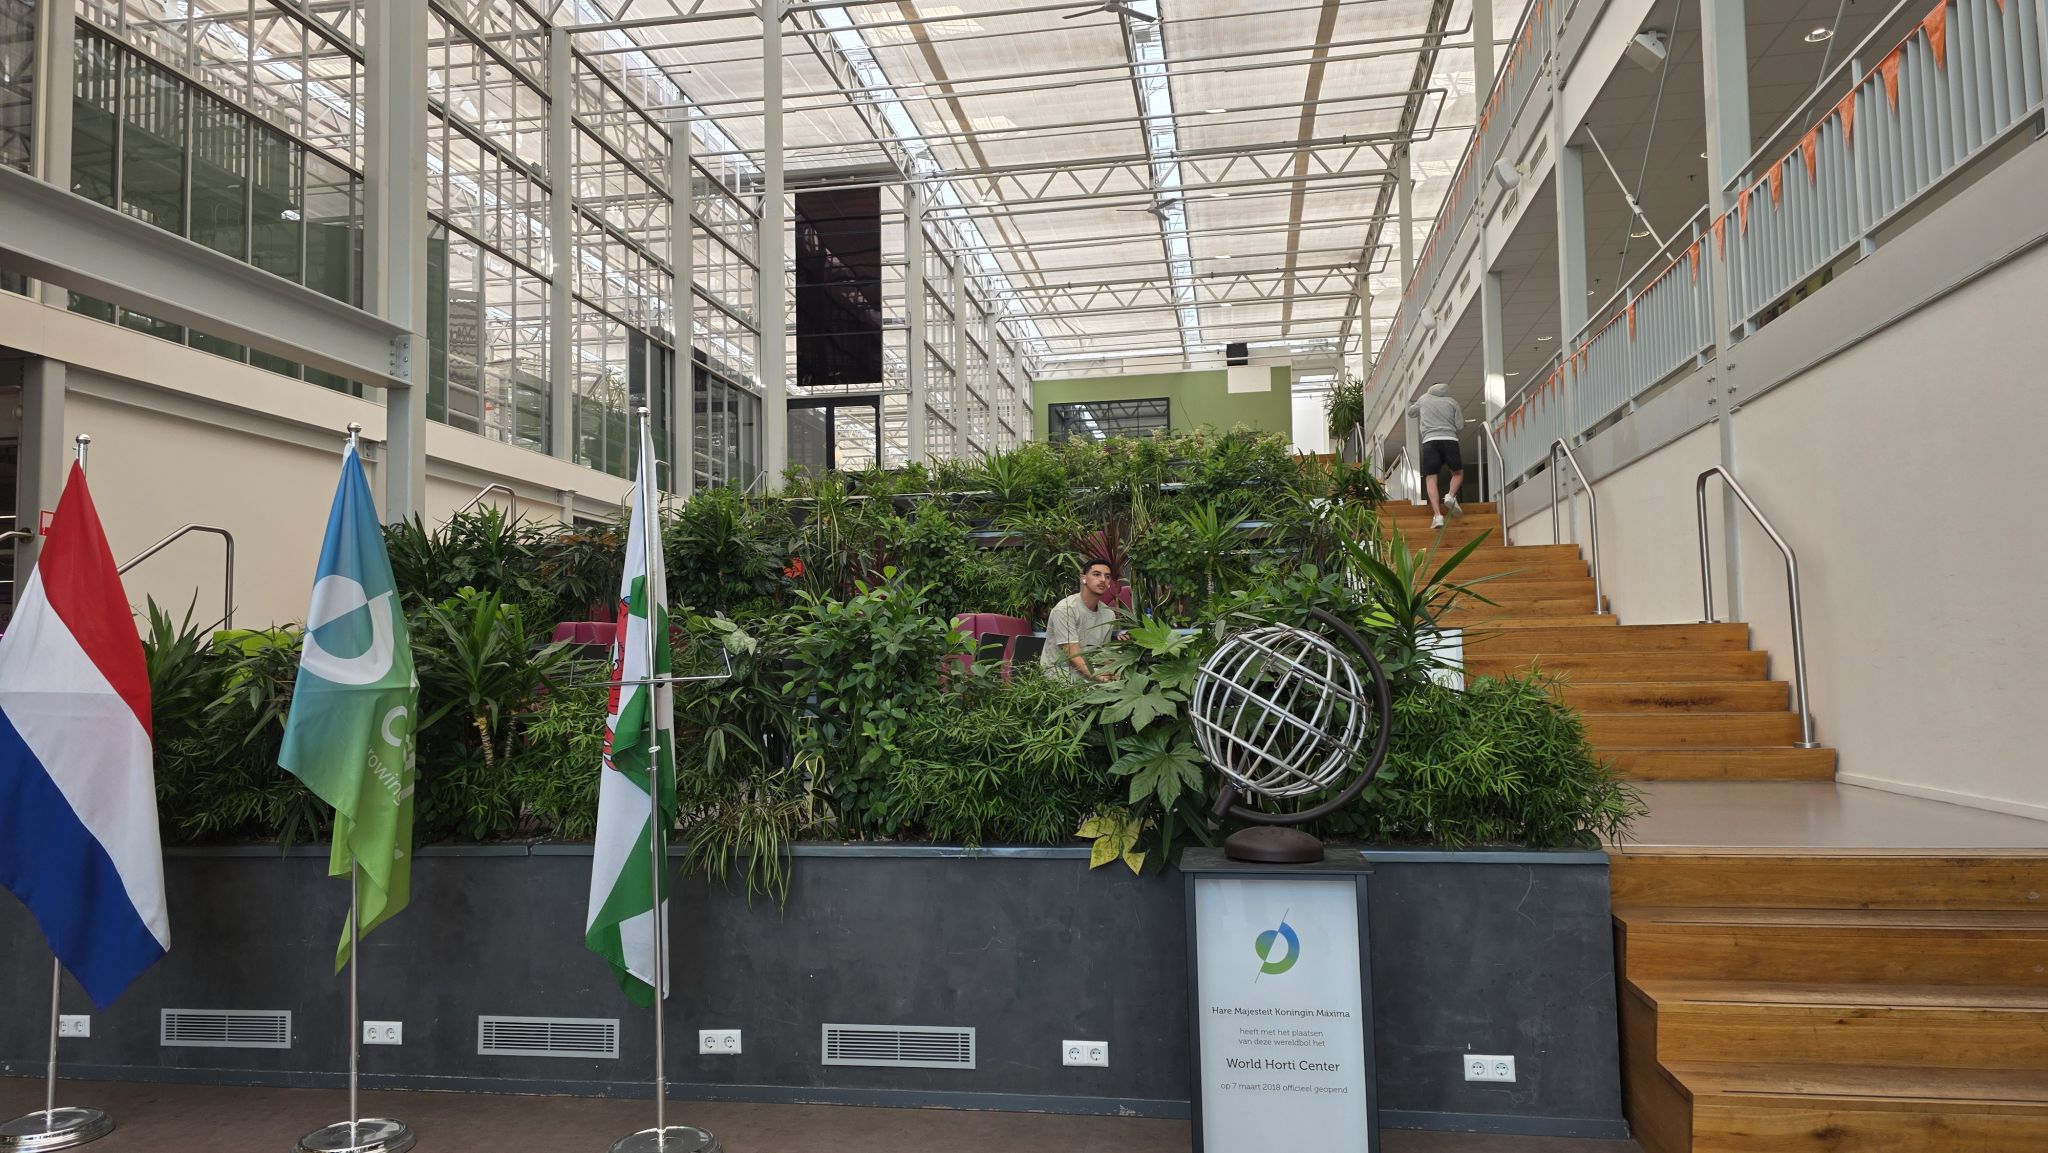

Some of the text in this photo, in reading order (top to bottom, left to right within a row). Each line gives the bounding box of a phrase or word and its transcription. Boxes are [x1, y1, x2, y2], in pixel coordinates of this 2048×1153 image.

[1211, 1006, 1232, 1015] Hare
[1234, 1007, 1273, 1017] Majesteit
[1274, 1008, 1314, 1019] Koningin
[1239, 1027, 1259, 1036] heeft
[1291, 1029, 1324, 1038] plaatsen
[1253, 1037, 1272, 1046] deze
[1273, 1039, 1311, 1047] wereldbol
[1312, 1039, 1326, 1048] het
[1226, 1057, 1340, 1072] World Horti Center
[1220, 1083, 1231, 1091] op
[1238, 1083, 1261, 1091] maart
[1262, 1083, 1281, 1091] 2018
[1282, 1084, 1312, 1092] officieel
[1313, 1085, 1349, 1094] geopend
